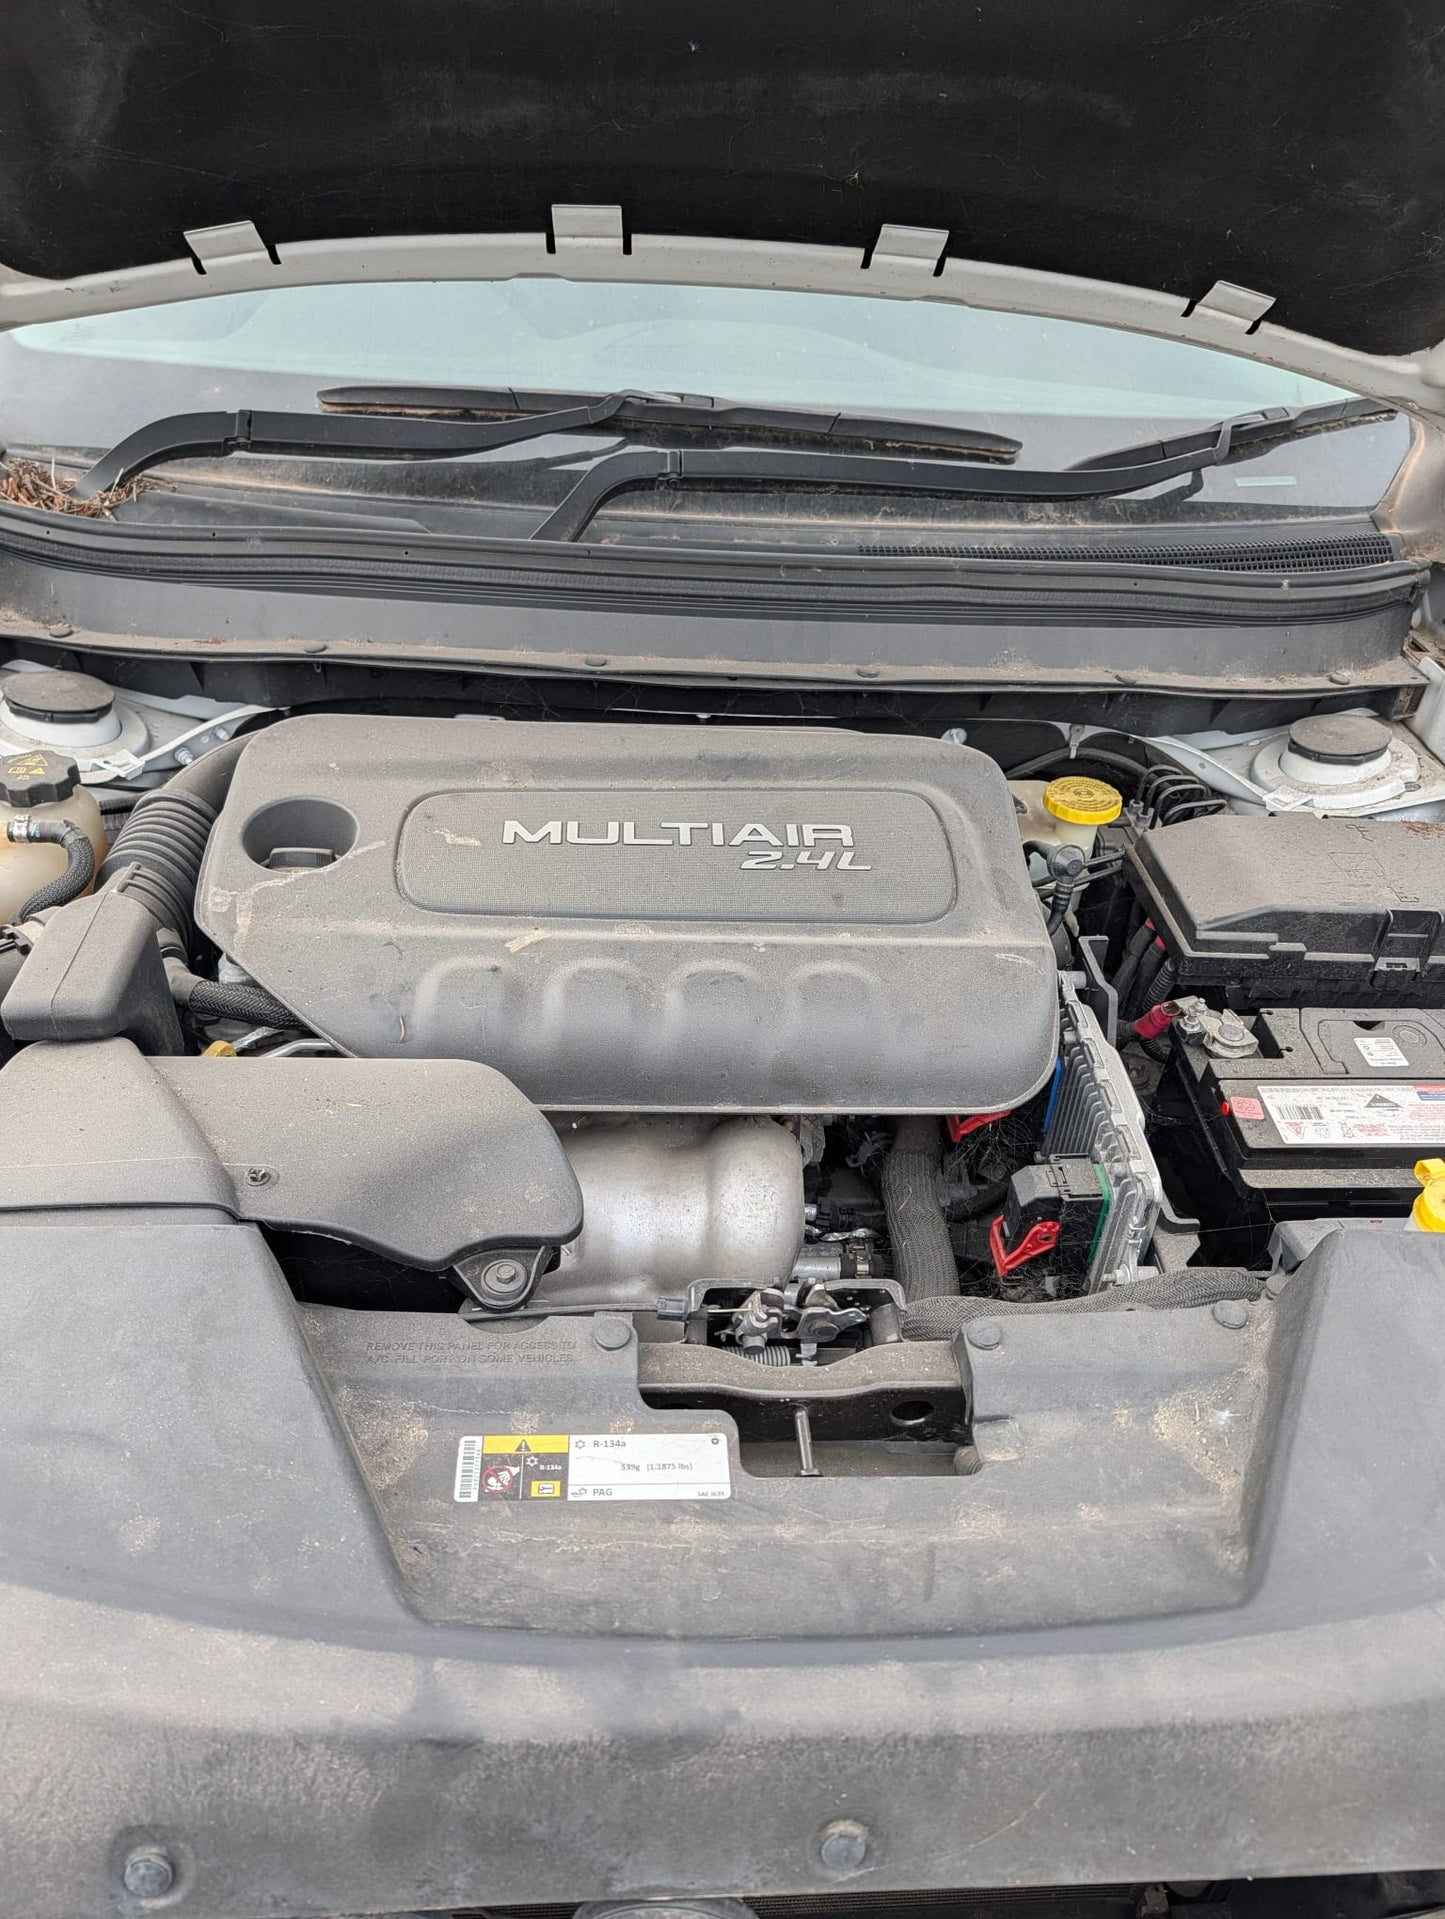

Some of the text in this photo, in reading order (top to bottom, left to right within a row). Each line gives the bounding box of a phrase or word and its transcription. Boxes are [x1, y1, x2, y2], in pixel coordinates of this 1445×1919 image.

[502, 820, 855, 847] MULTIAIR
[740, 850, 872, 871] 2.4L
[366, 1341, 577, 1351] REMOVE THIS PANEL FOR ACCESS TO
[395, 1354, 419, 1364] FILL
[479, 1354, 513, 1363] SOME
[519, 1353, 573, 1363] VEHICLES
[593, 1439, 627, 1448] R-134a
[621, 1462, 693, 1472] 539g (1.1875 lbs)
[592, 1488, 613, 1497] PAG
